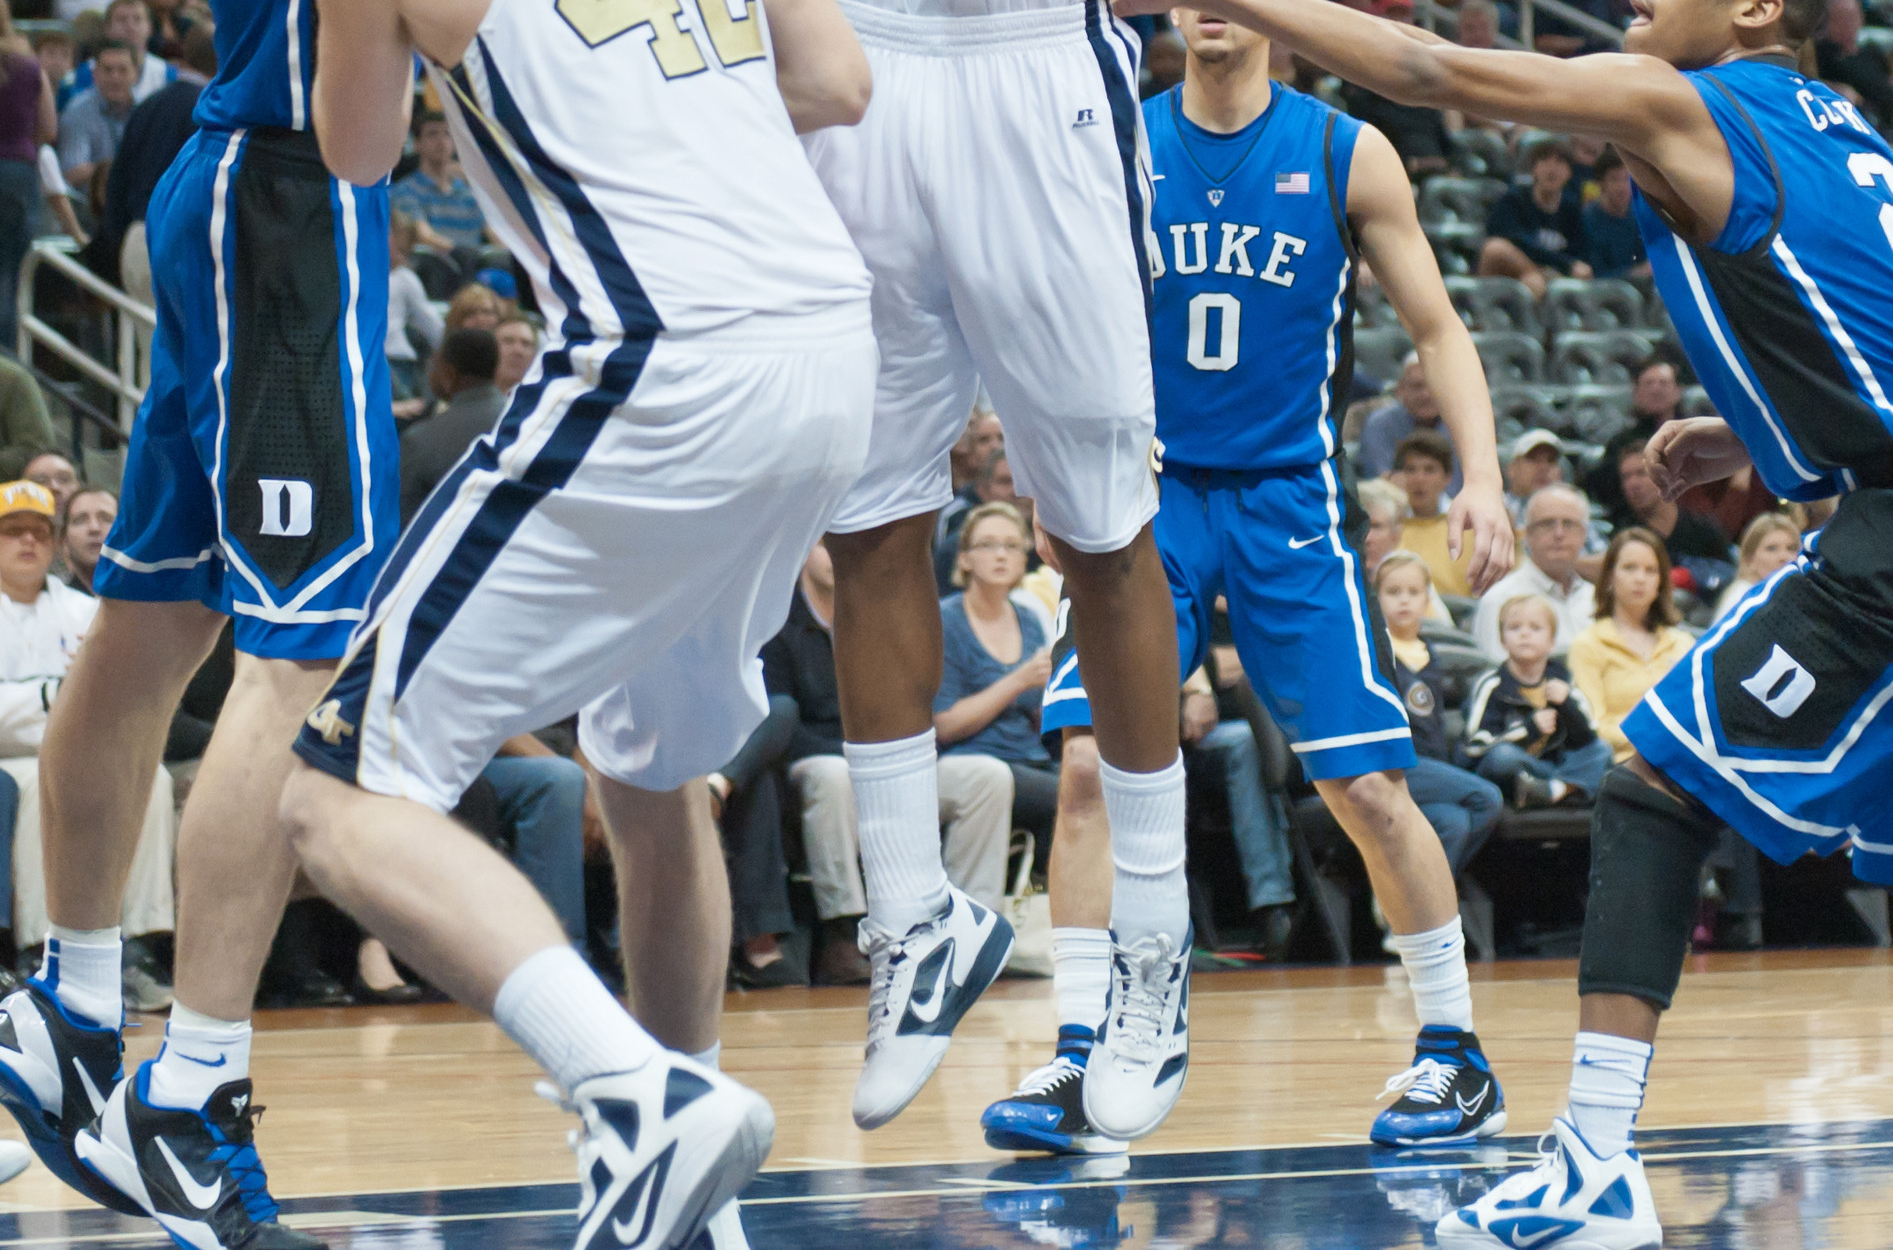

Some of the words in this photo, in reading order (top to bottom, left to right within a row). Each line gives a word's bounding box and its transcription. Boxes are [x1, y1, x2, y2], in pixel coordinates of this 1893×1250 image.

[1187, 292, 1241, 371] 0
[257, 479, 313, 536] D
[1740, 643, 1817, 718] D
